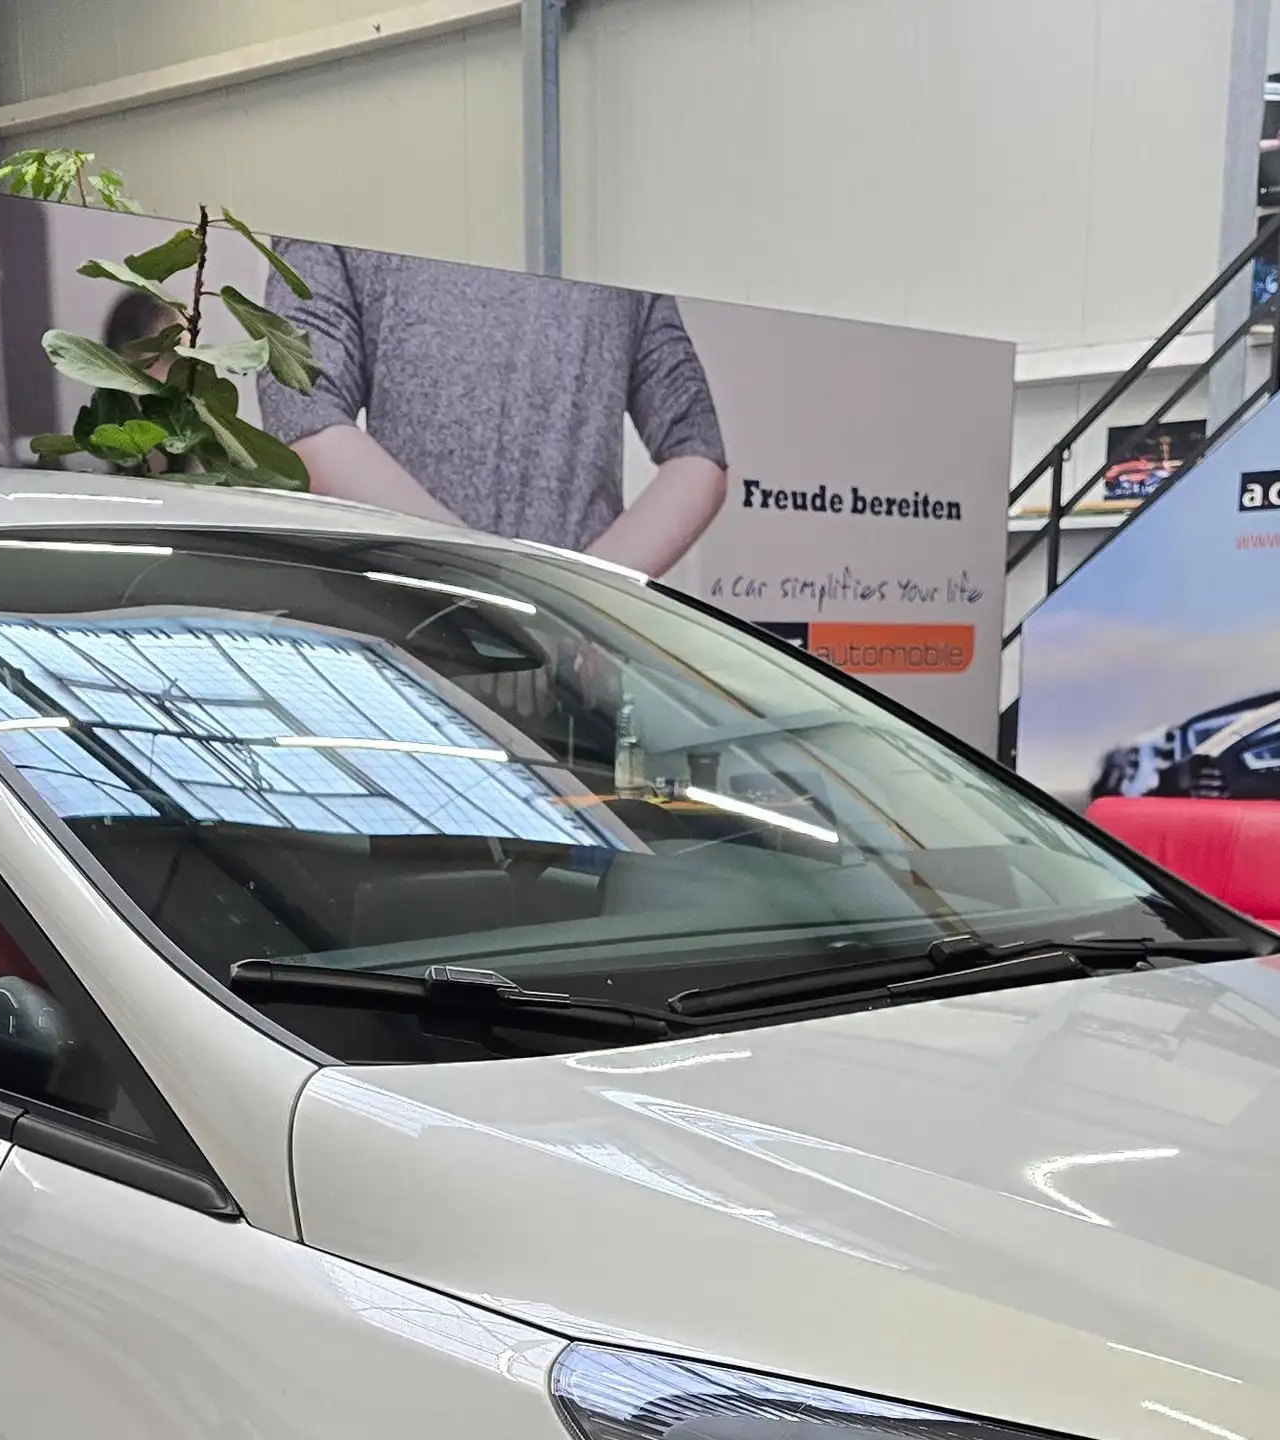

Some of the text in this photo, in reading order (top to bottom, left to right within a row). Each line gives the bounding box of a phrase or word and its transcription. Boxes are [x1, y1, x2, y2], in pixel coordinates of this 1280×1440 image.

[742, 479, 962, 520] Freude bereiten
[711, 577, 724, 597] a
[780, 566, 889, 614] simplifies
[947, 570, 985, 604] life
